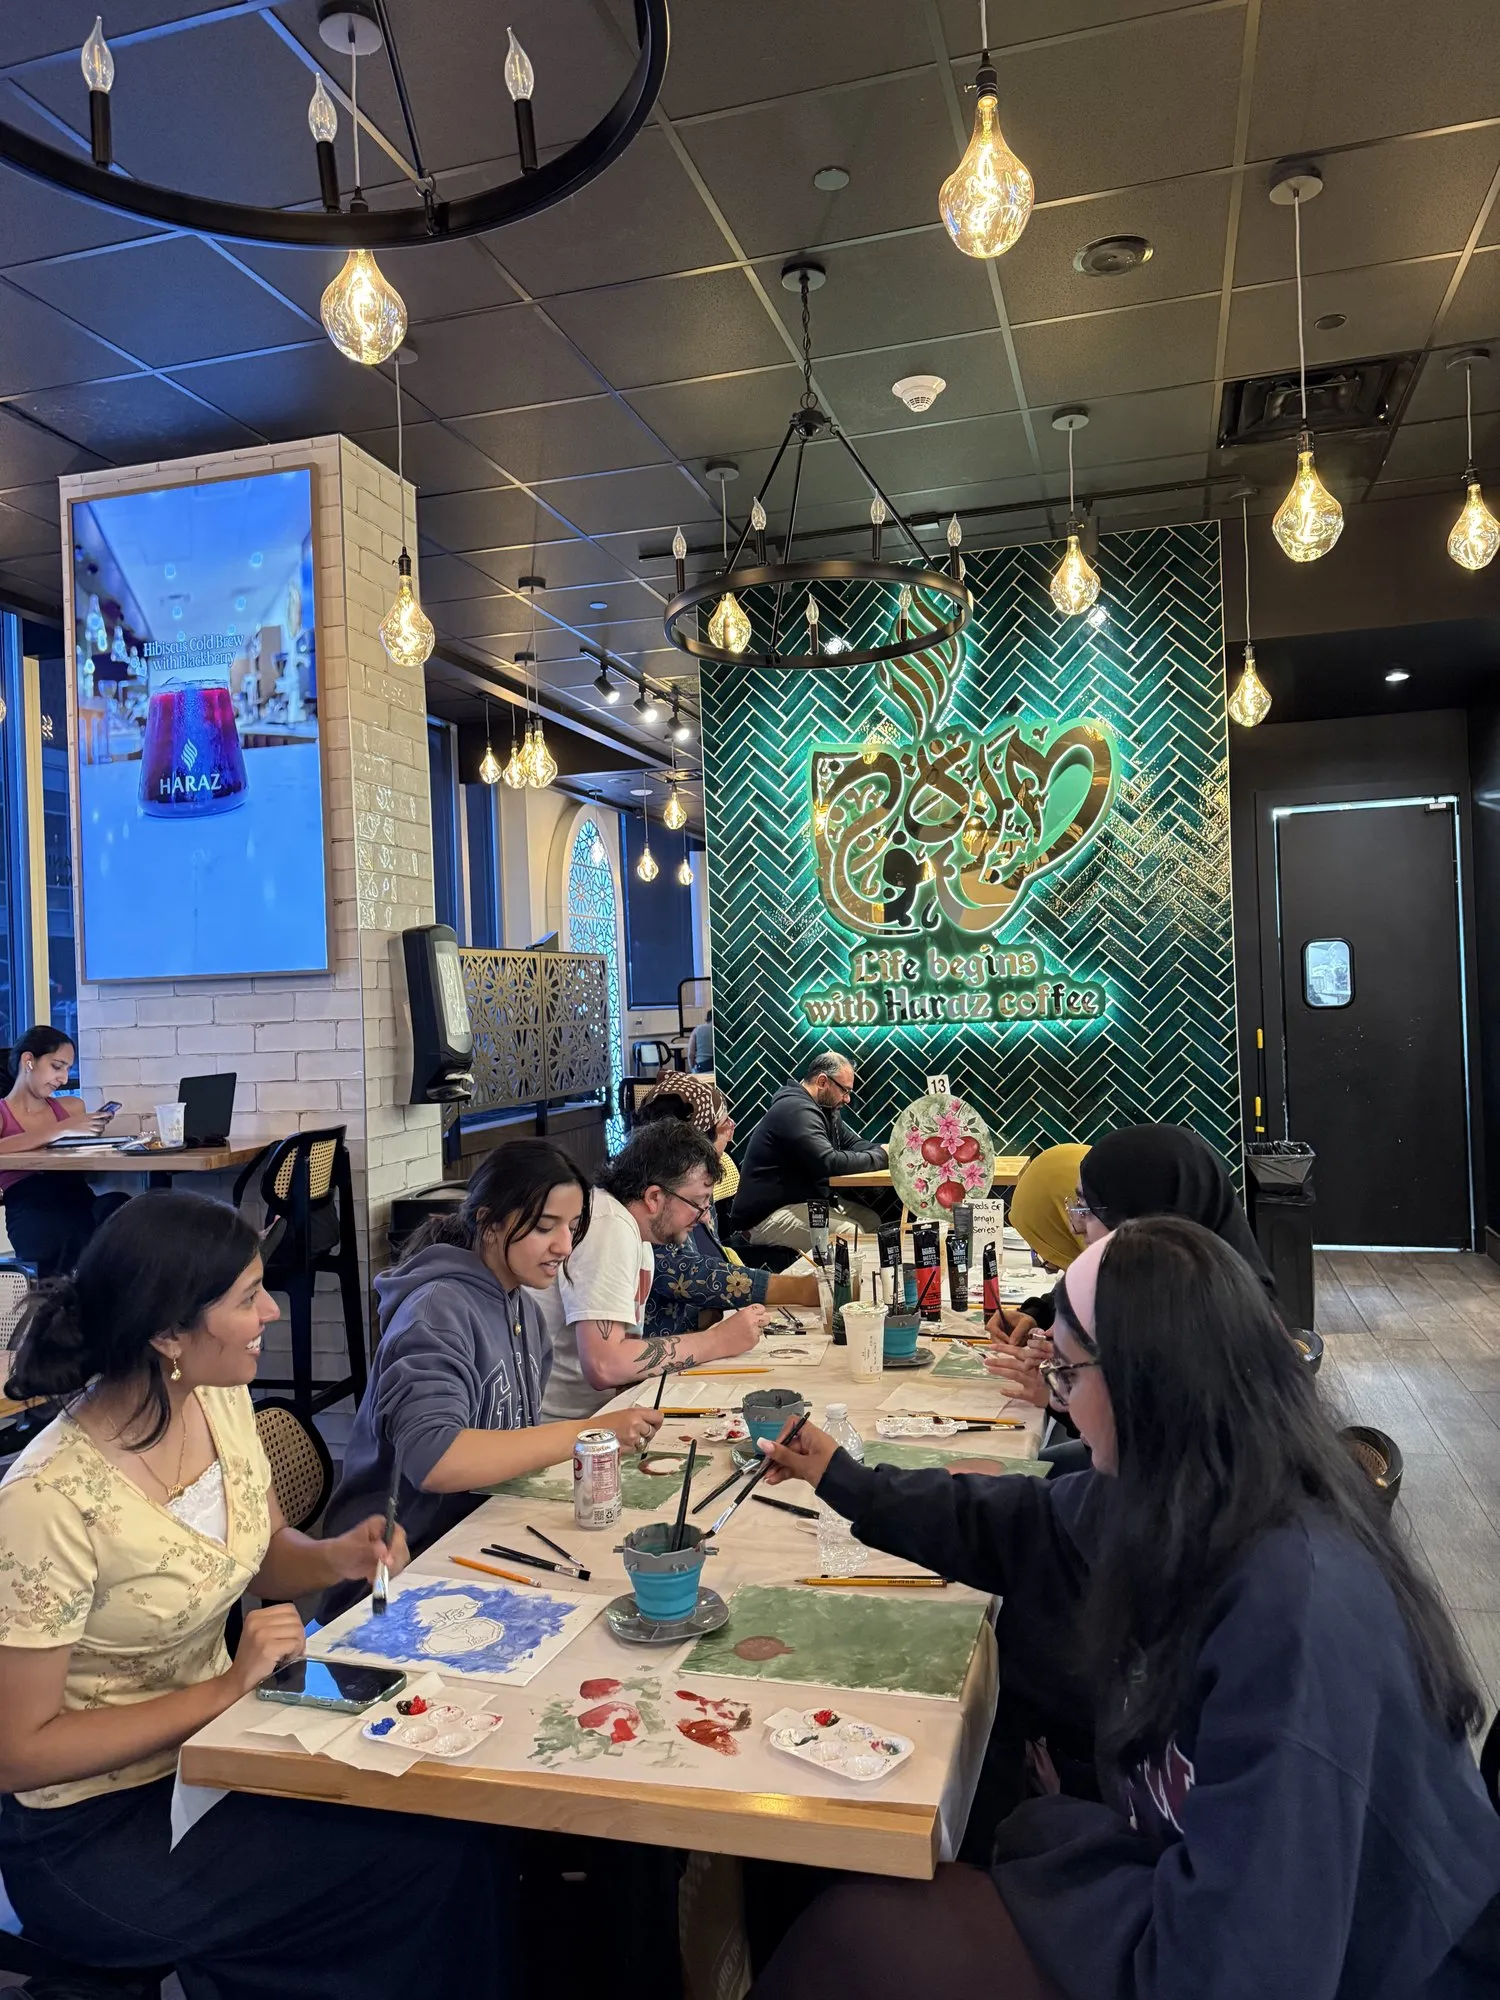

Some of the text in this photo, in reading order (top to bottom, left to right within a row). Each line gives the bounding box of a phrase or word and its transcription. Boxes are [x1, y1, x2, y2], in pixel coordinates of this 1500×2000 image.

[143, 634, 244, 657] Hibiscus Cold Brew
[153, 651, 236, 671] with Blackberry
[160, 773, 222, 795] HARAZ
[855, 944, 1038, 987] Life begins
[804, 981, 1100, 1024] with Haraz coffee
[931, 1078, 946, 1094] 13
